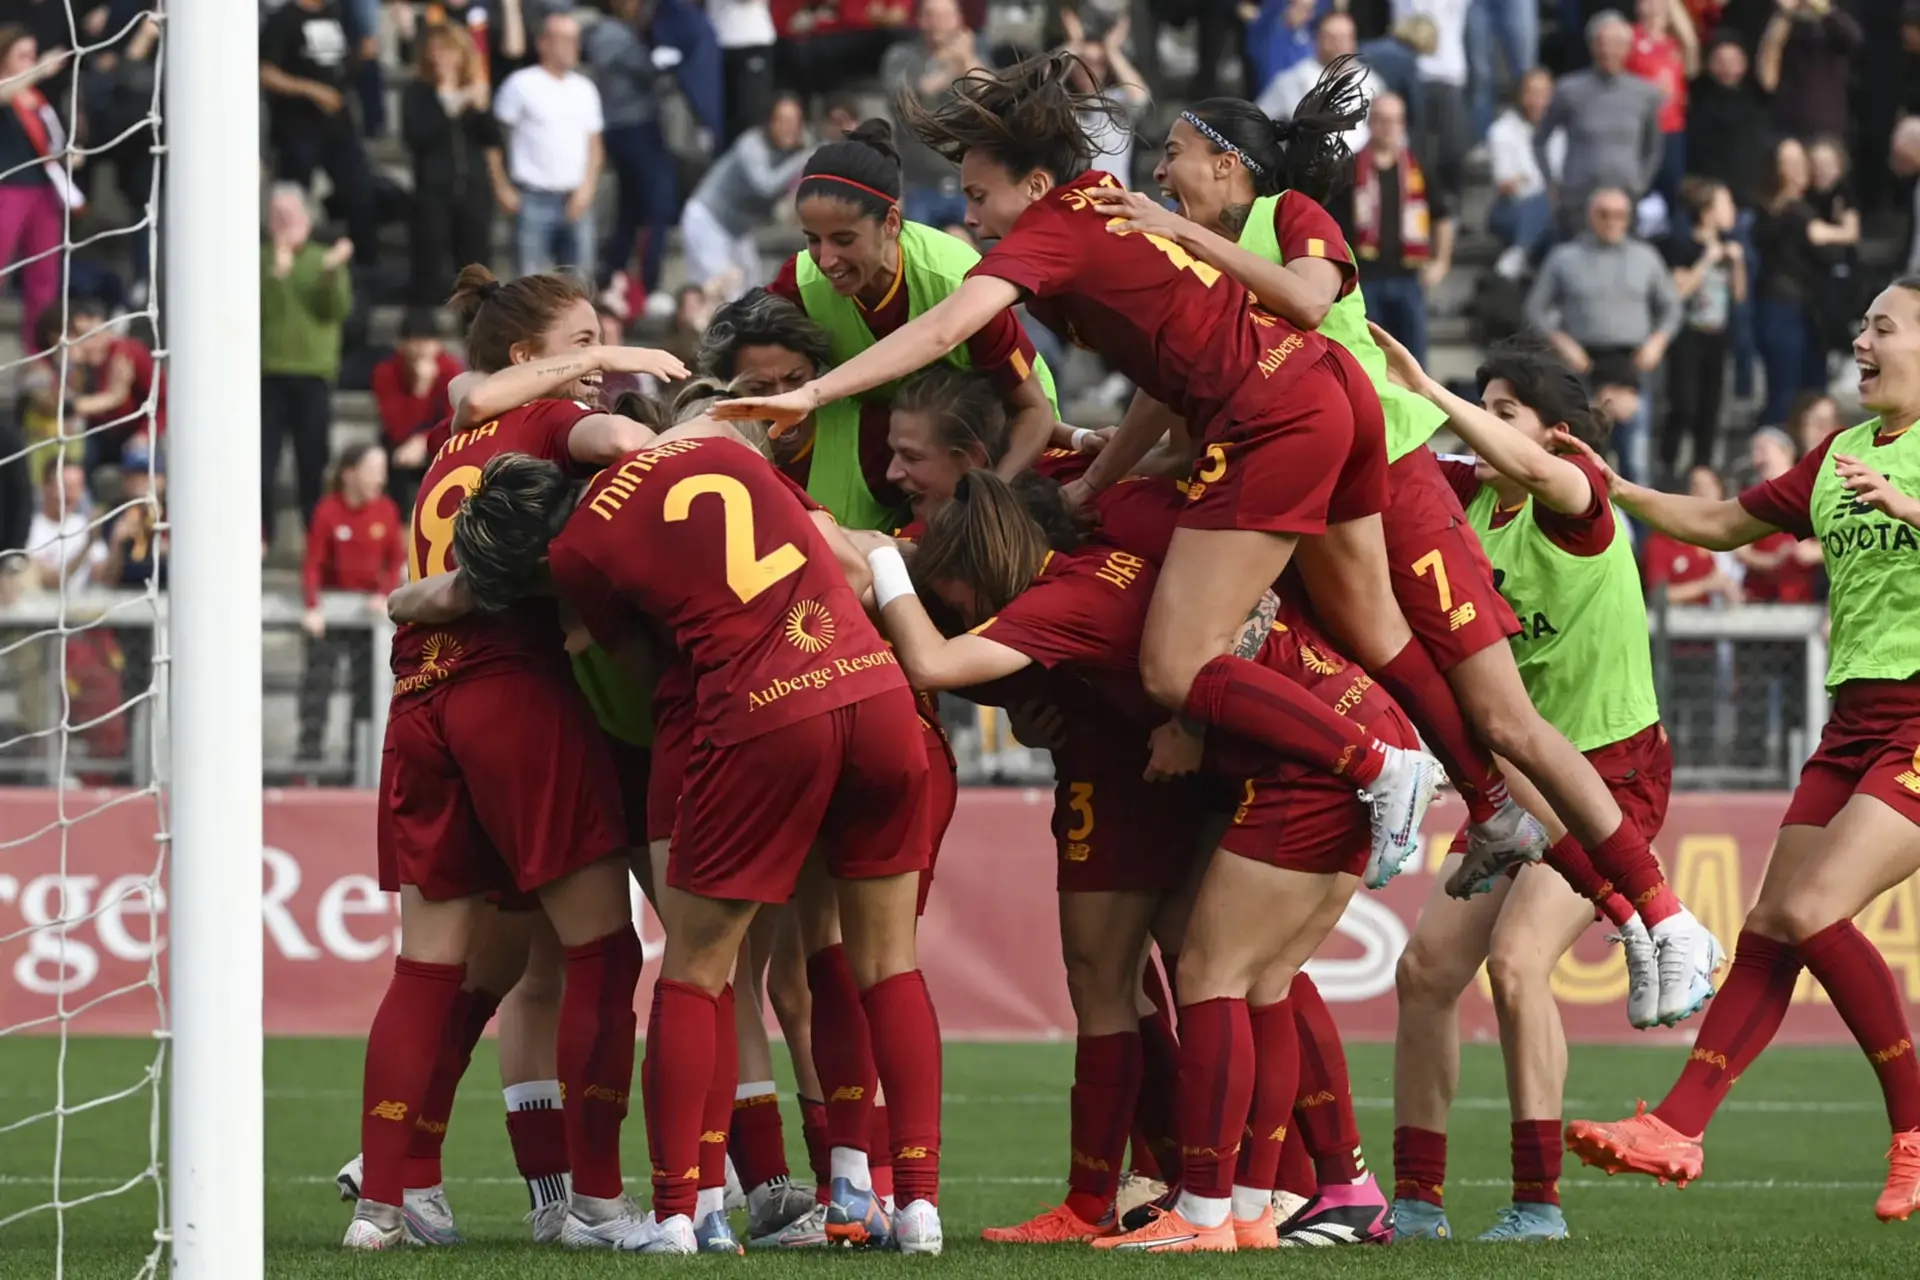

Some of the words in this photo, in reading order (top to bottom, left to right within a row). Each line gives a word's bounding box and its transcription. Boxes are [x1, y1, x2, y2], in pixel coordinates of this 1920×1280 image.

[1257, 333, 1305, 380] Auberge
[589, 439, 704, 521] MINAMI
[663, 473, 808, 605] 2
[1411, 549, 1453, 613] 7
[748, 666, 834, 713] Auberge
[1067, 782, 1095, 842] 3
